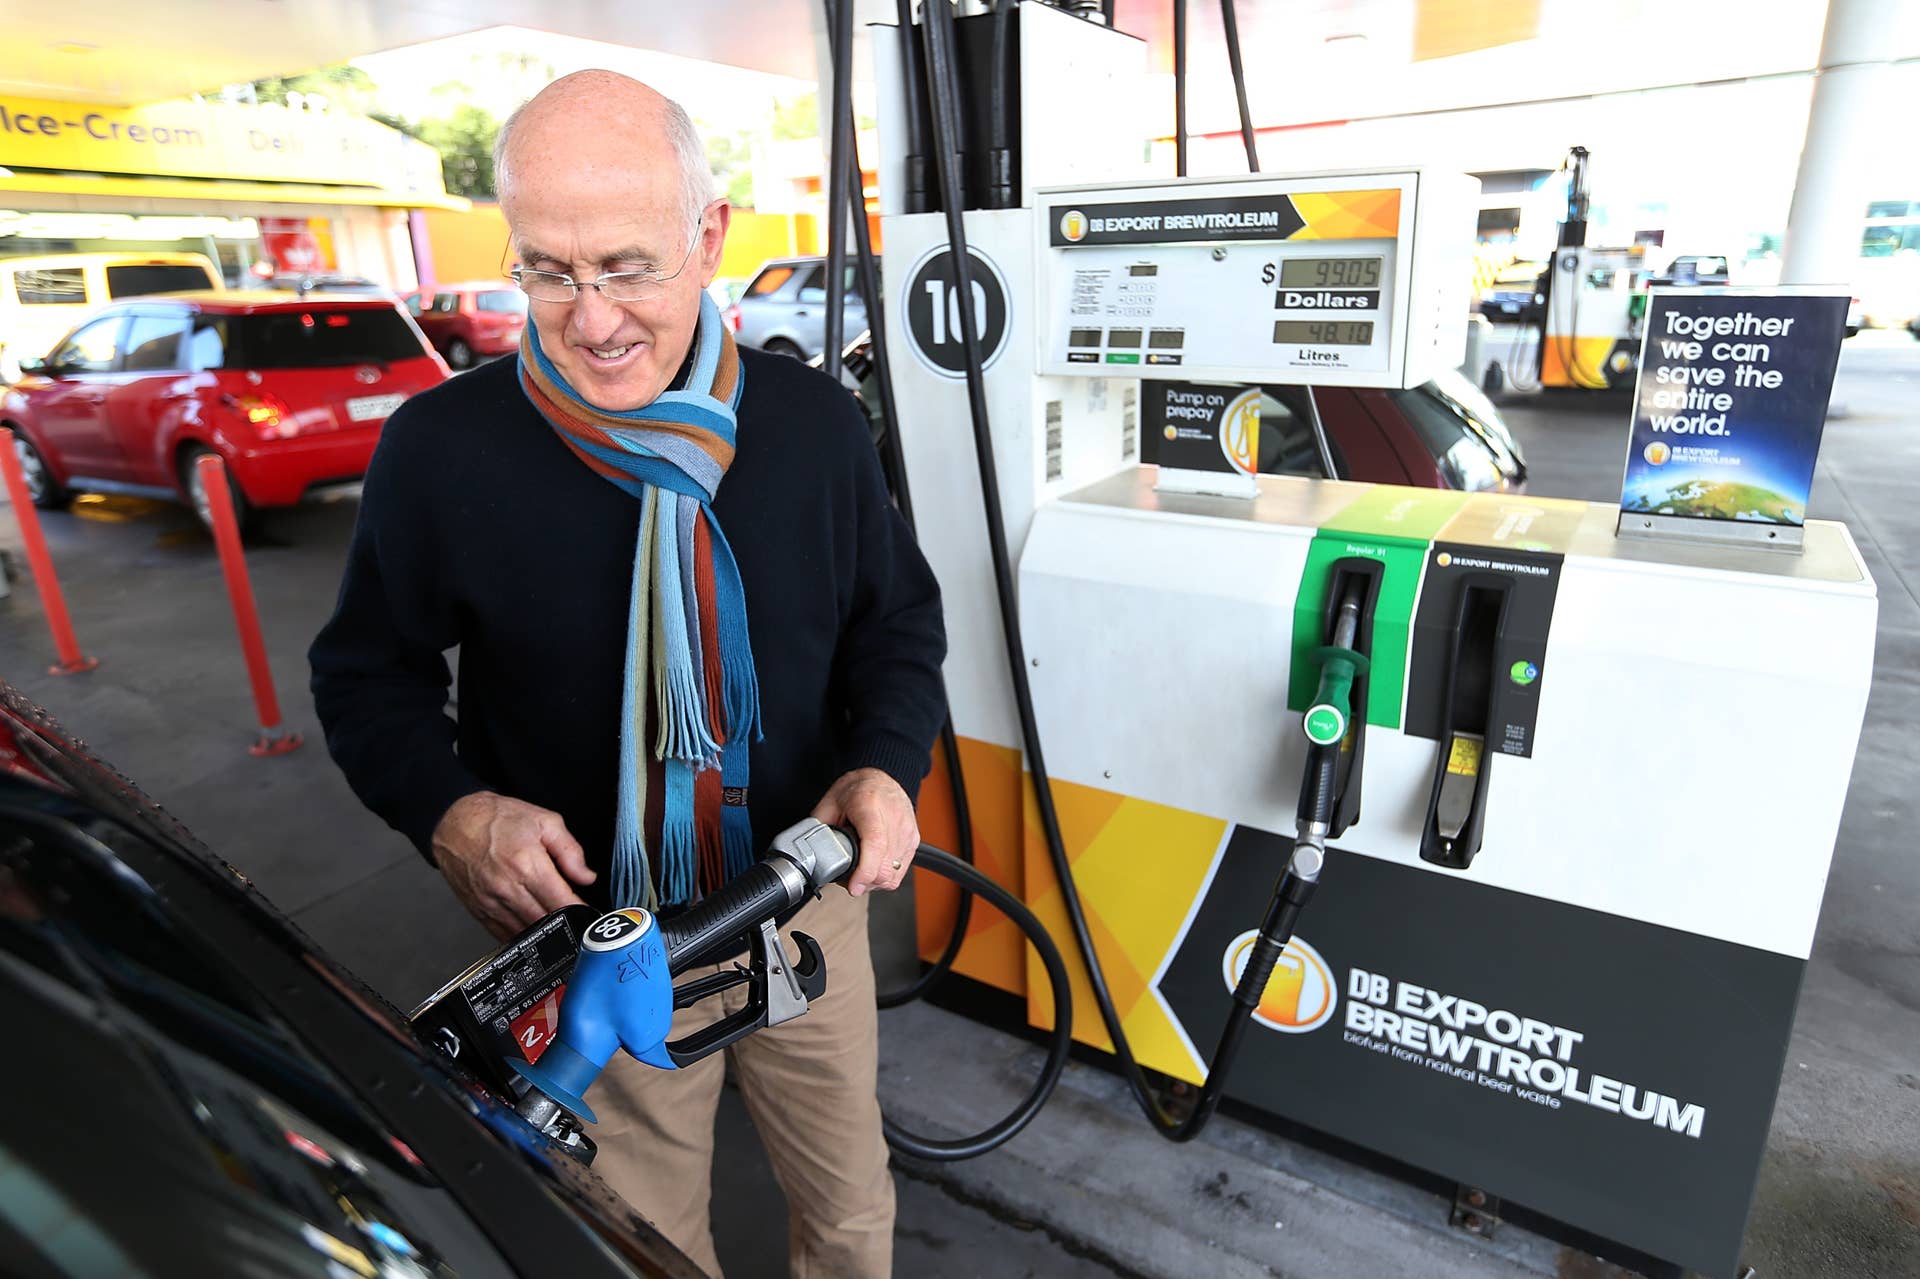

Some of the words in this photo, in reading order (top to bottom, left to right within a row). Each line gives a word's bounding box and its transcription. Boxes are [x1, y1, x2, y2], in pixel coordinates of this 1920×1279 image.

[0, 105, 203, 147] Ice-Cream
[1105, 216, 1162, 232] EXPORT
[1164, 212, 1279, 230] BREWTROLEUM
[925, 280, 987, 344] 10
[1284, 292, 1369, 308] Dollars
[1665, 311, 1795, 341] Together
[1299, 349, 1340, 361] Litres
[1661, 341, 1703, 361] we
[1711, 342, 1770, 363] can
[1655, 365, 1726, 386] save
[1734, 364, 1783, 389] the
[1167, 389, 1204, 407] Pump
[1206, 394, 1225, 406] on
[1653, 387, 1734, 412] entire
[1166, 405, 1215, 422] prepay
[1650, 413, 1731, 437] world.
[493, 947, 519, 967] PRESSURE
[522, 997, 533, 1008] 95
[533, 985, 551, 1002] (min.
[1348, 968, 1390, 1005] DB
[1395, 981, 1584, 1062] EXPORT
[1343, 1030, 1389, 1055] biofuel
[1391, 1045, 1424, 1065] from
[1425, 1057, 1476, 1082] natural
[1478, 1072, 1513, 1094] beer
[1516, 1086, 1562, 1110] waste
[1345, 999, 1706, 1139] BREWTROLEUM
